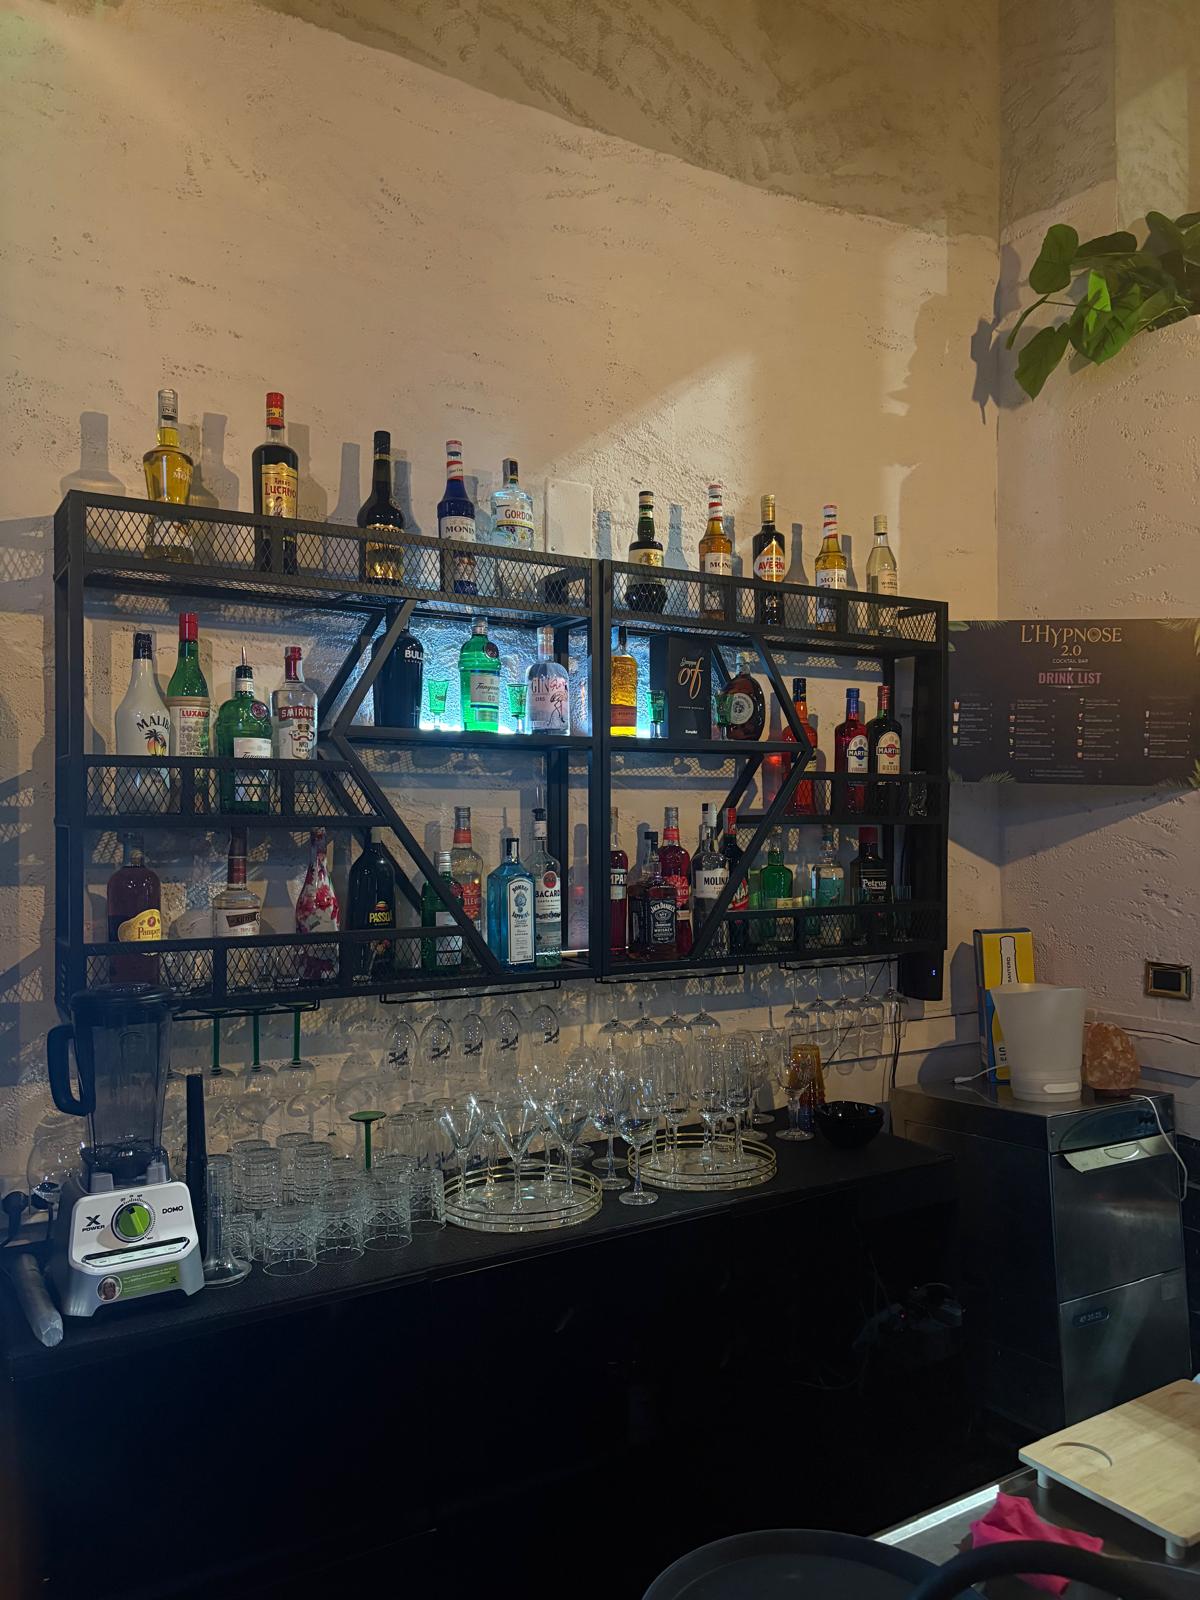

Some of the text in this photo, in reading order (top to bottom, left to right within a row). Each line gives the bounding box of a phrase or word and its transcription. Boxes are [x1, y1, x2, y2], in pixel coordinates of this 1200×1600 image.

[1060, 645, 1082, 656] 2.0
[1038, 672, 1102, 684] DRINK LIST
[161, 1205, 184, 1215] DOMO
[81, 1224, 105, 1232] POWER
